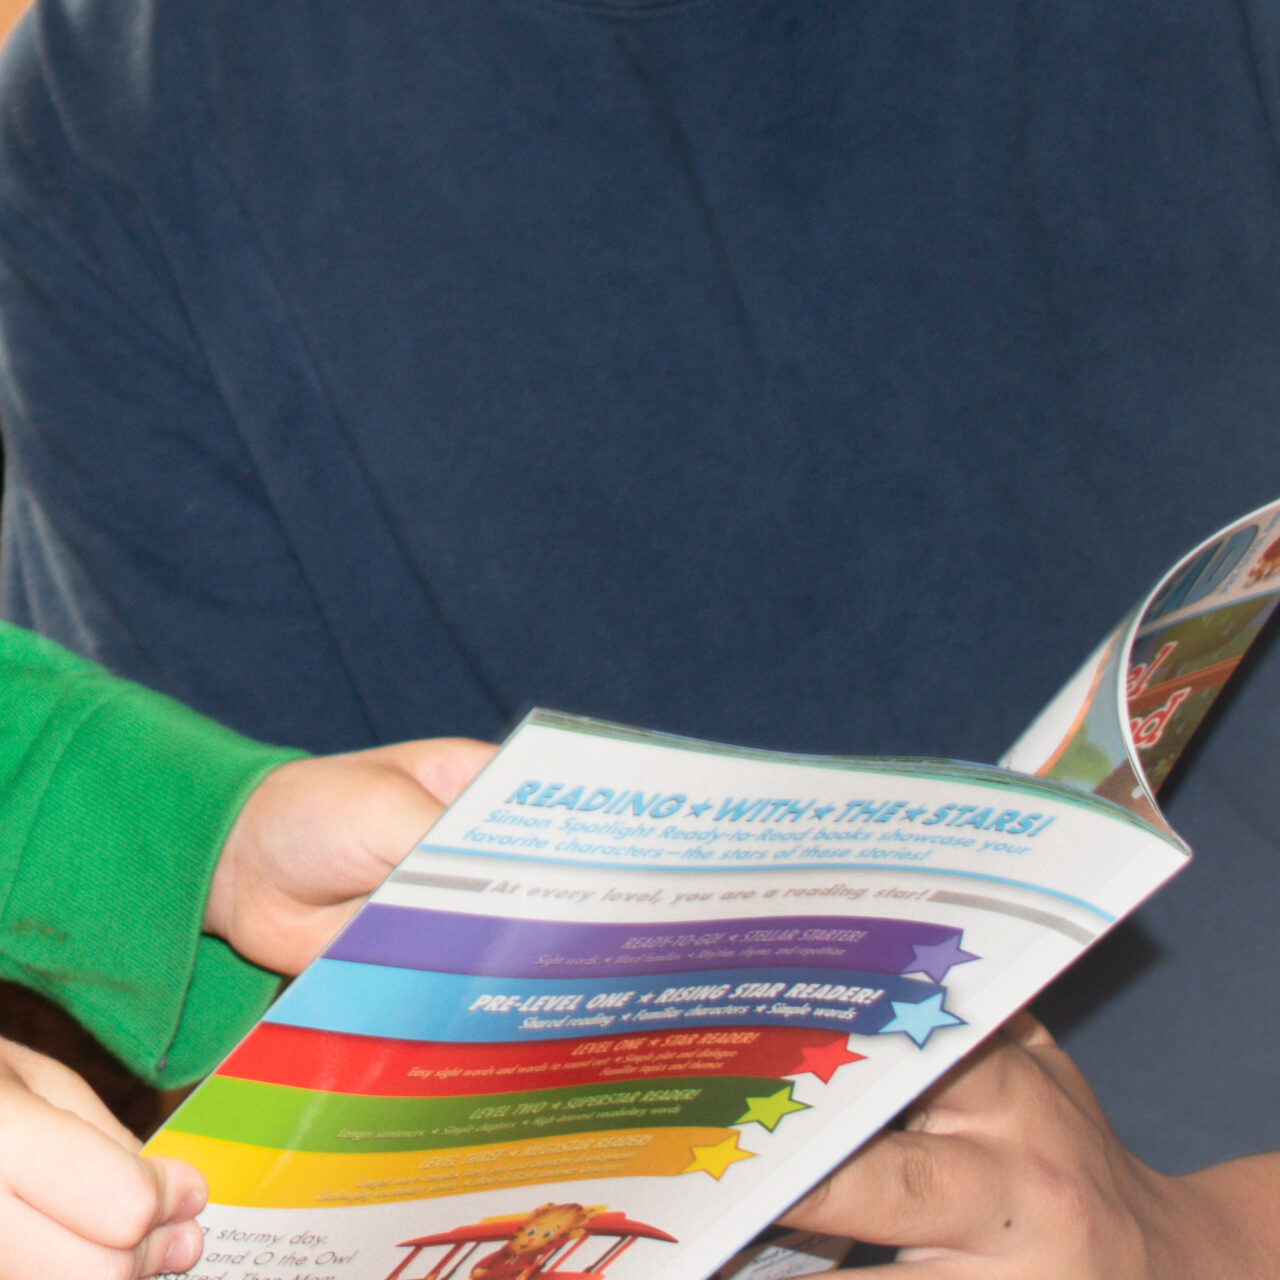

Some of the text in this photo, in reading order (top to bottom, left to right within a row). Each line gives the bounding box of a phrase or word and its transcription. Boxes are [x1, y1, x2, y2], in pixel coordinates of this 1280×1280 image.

[504, 779, 1058, 838] READING WITH THE STARS!
[461, 826, 550, 849] favorite
[718, 844, 767, 861] stars
[773, 845, 795, 859] of
[798, 846, 851, 859] these
[856, 847, 934, 862] stories!
[483, 809, 1032, 856] Simon Spotlight Ready-to-Read books showcase your
[488, 879, 931, 905] At every level, you are a reading star!
[470, 983, 886, 1012] PRE-LEVEL ONE RISING STAR READER!
[519, 1015, 570, 1030] Shared
[567, 1014, 617, 1028] reading
[685, 1004, 751, 1018] characters
[767, 1003, 812, 1018] Simple
[813, 1006, 858, 1020] words
[572, 1033, 762, 1056] LEVEL ONE STAR READER!
[470, 1105, 512, 1120] LEVEL
[216, 1228, 328, 1248] stormy day.
[206, 1249, 360, 1265] and O the Owl
